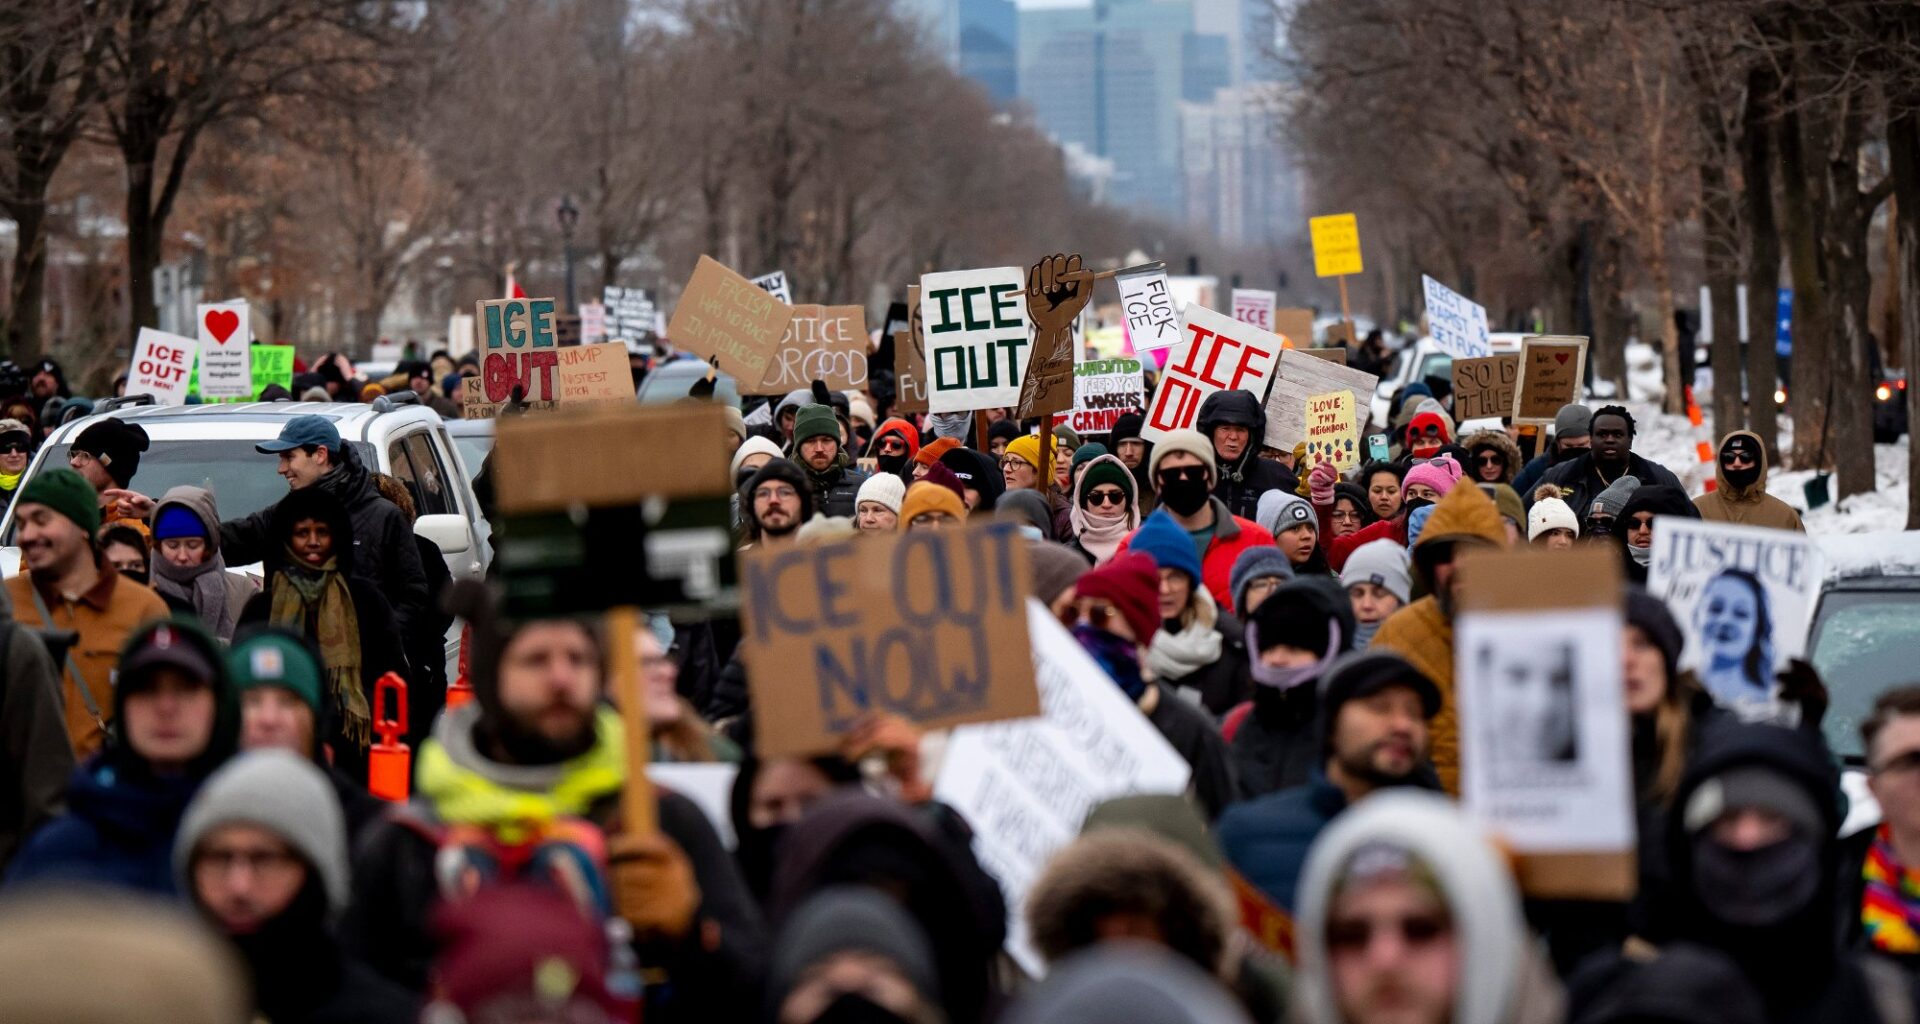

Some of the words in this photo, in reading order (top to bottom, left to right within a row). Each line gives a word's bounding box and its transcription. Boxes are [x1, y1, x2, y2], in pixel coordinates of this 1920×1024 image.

[486, 301, 555, 348] ICE
[929, 283, 1024, 334] ICE
[1124, 291, 1152, 331] ICE
[1146, 279, 1177, 338] FUCK
[1235, 307, 1268, 326] ICE
[138, 361, 186, 382] OUT
[146, 343, 185, 364] ICE
[483, 350, 559, 403] OUT
[933, 338, 1028, 392] OUT
[1457, 360, 1494, 389] SO
[1313, 397, 1341, 413] LOVE
[1318, 413, 1336, 424] THY
[745, 542, 862, 643] ICE
[891, 521, 1020, 628] OUT
[1658, 531, 1810, 593] JUSTICE
[814, 625, 991, 722] NOW
